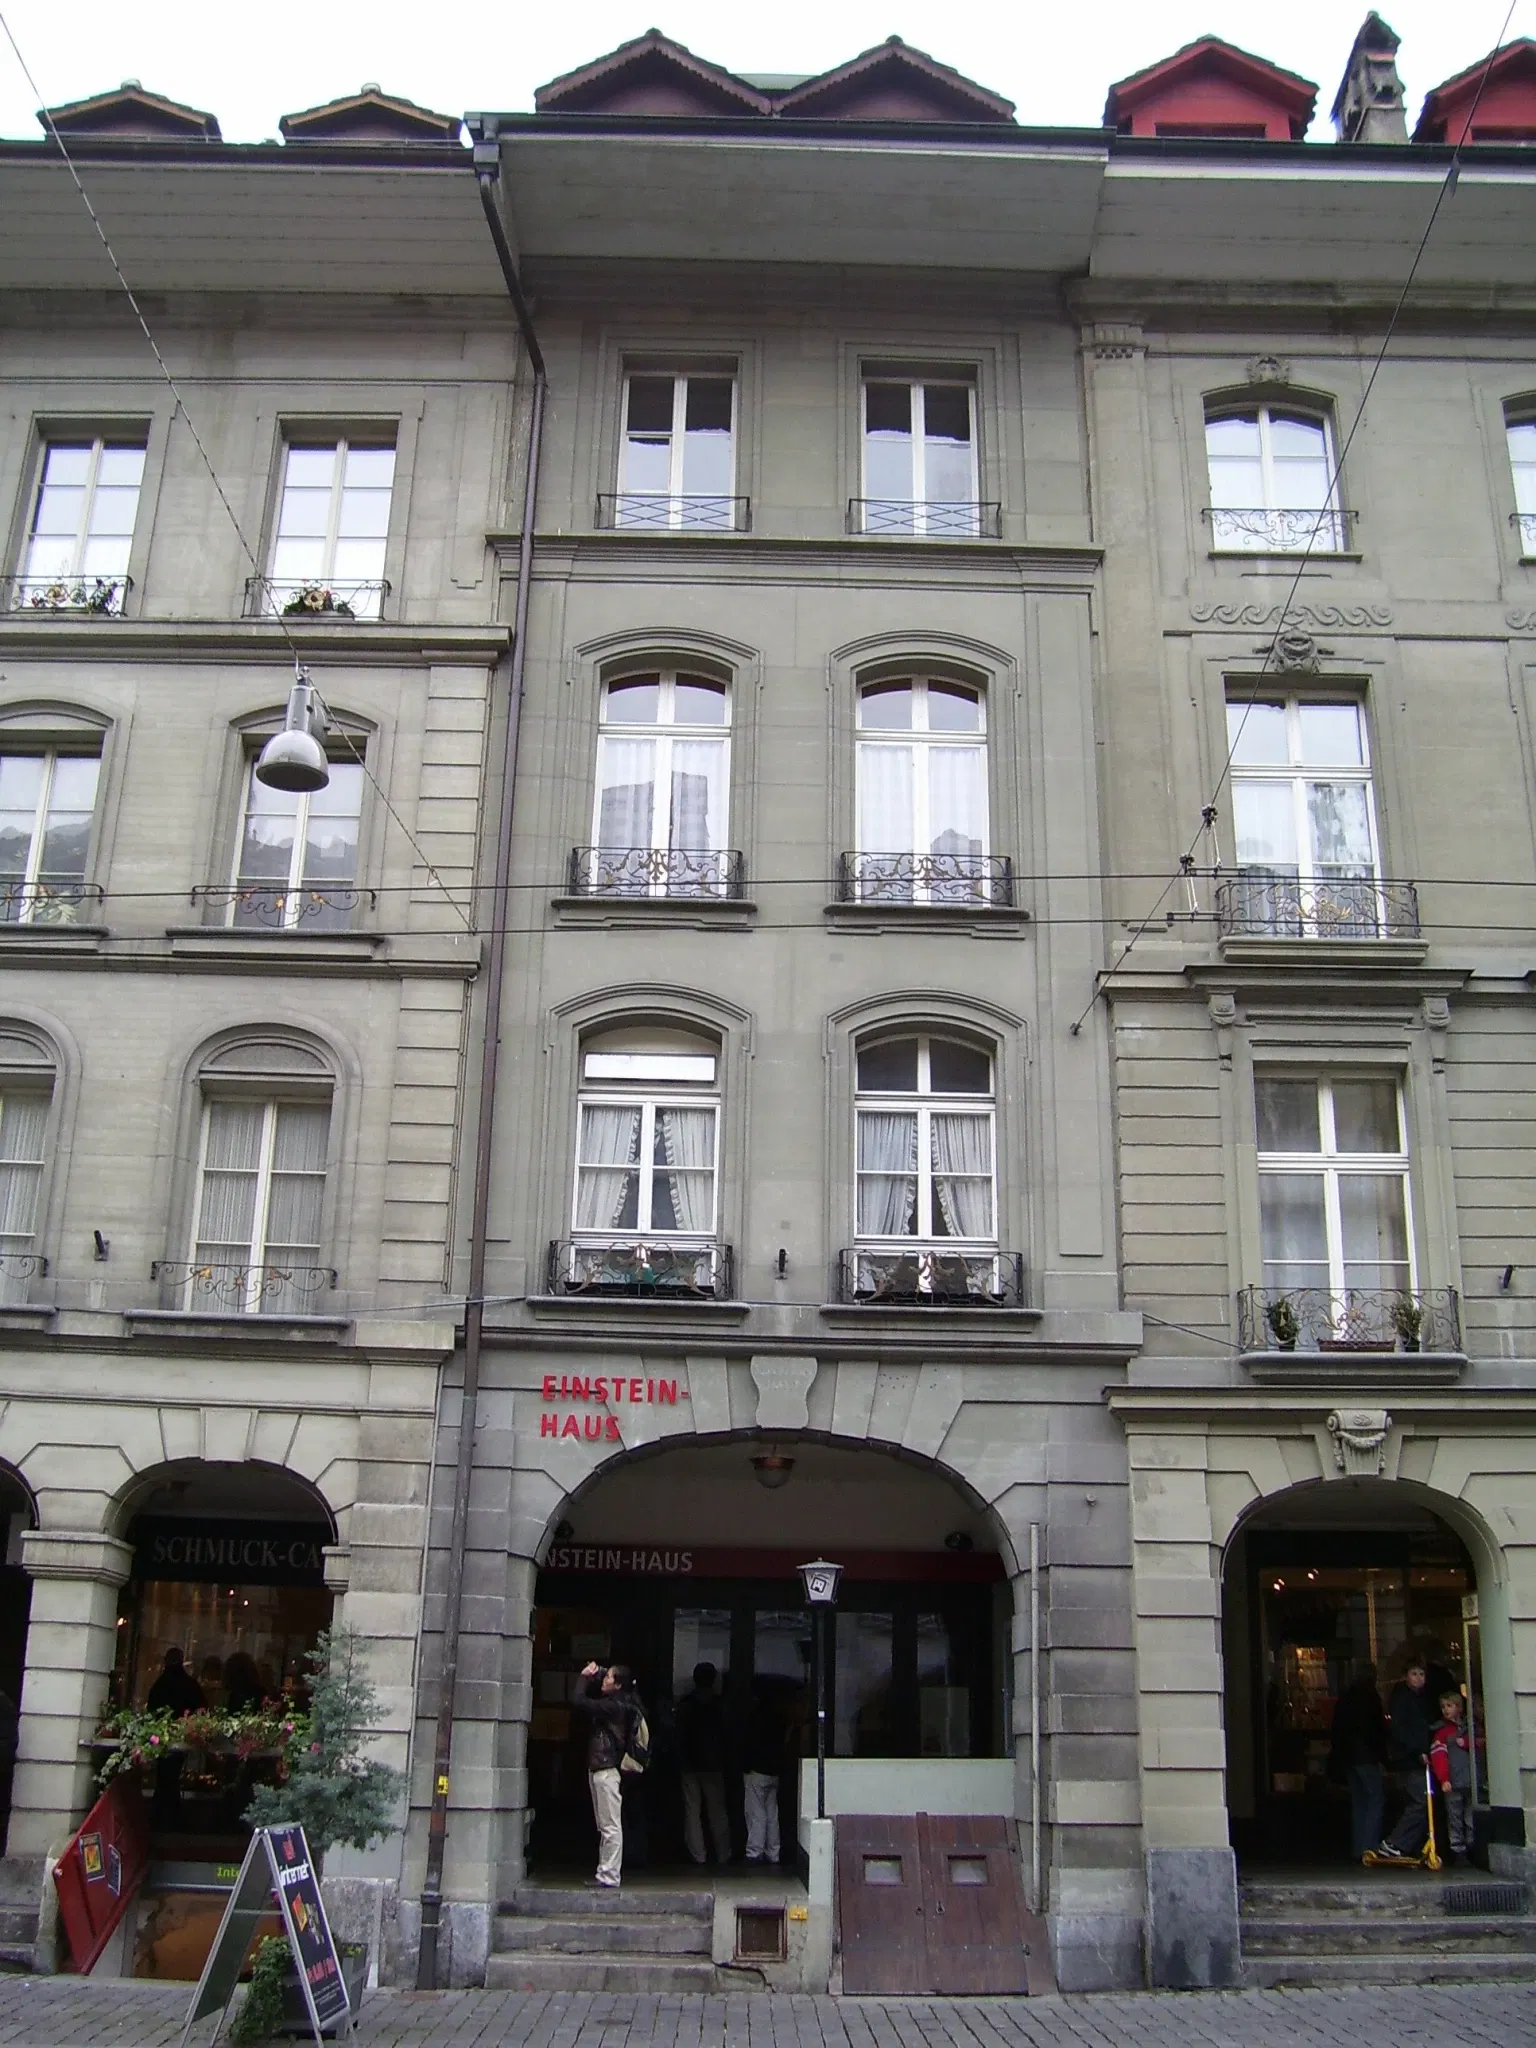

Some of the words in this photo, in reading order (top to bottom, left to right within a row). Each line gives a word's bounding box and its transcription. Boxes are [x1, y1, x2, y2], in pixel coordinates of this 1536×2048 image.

[541, 1375, 690, 1405] EINSTEIN-
[540, 1413, 620, 1442] HAUS
[279, 1858, 310, 1887] internet
